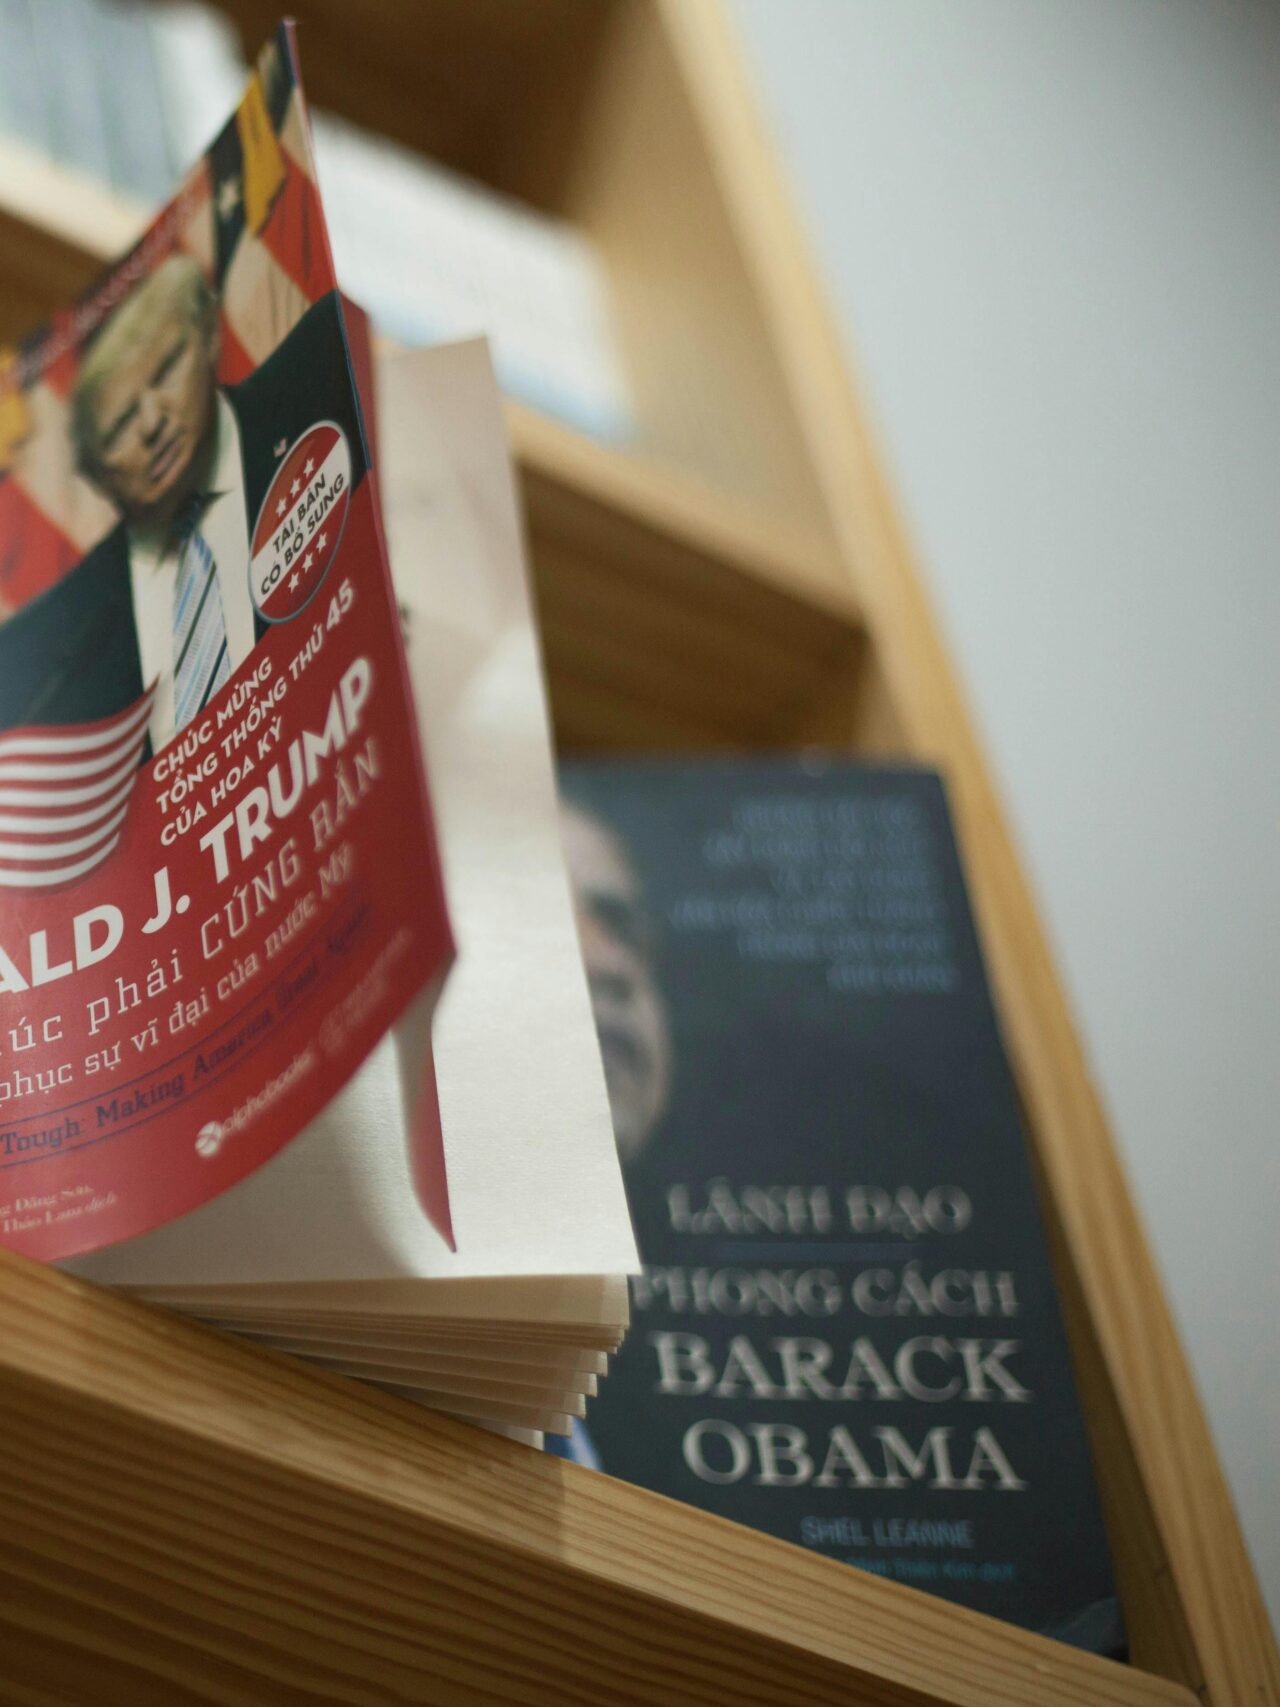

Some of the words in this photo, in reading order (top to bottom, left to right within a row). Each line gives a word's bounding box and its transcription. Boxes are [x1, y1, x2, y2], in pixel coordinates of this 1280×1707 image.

[307, 473, 344, 534] SUNG
[153, 720, 214, 782] CHÚC
[216, 656, 272, 729] MỪNG
[156, 752, 218, 814] TỔNG
[221, 676, 287, 758] THỐNG
[288, 623, 324, 681] THỨ
[326, 578, 355, 632] 45
[141, 866, 190, 934] J.
[199, 656, 372, 884] TRUMP
[160, 799, 207, 846] CỦA
[210, 755, 255, 808] HOA
[257, 715, 283, 761] KỲ
[84, 1040, 122, 1076] sự
[131, 1020, 159, 1052] vĩ
[168, 987, 211, 1036] đại
[216, 952, 260, 1003] của
[264, 891, 319, 960] nước
[86, 949, 184, 1037] phải
[201, 837, 301, 960] CỨNG
[95, 1073, 185, 1128] Making
[650, 1331, 1033, 1403] BARACK
[682, 1418, 1028, 1491] OBAMA
[801, 1516, 870, 1548] SHEL
